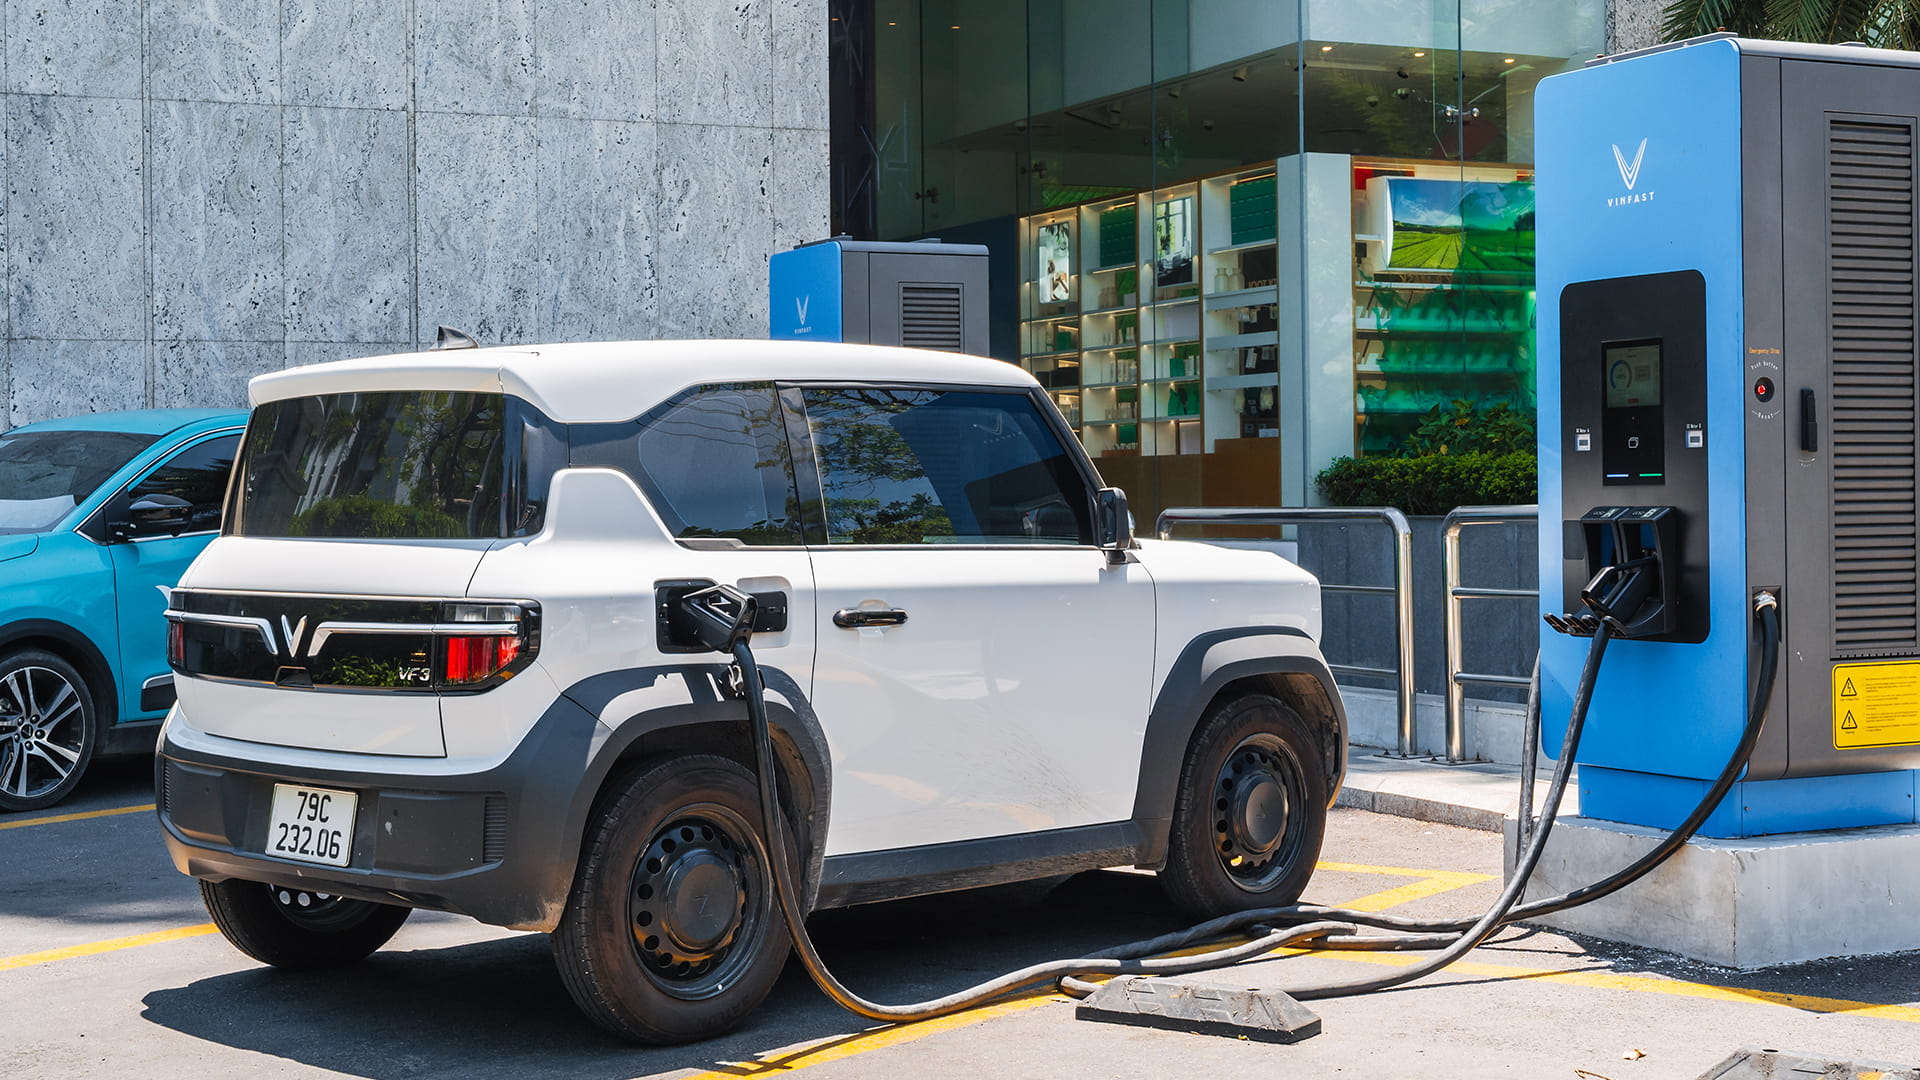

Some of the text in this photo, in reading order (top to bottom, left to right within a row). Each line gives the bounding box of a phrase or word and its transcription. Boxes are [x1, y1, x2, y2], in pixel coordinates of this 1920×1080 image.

[1607, 191, 1655, 208] VINFAST
[296, 791, 332, 823] 79C
[275, 822, 342, 860] 232.06
